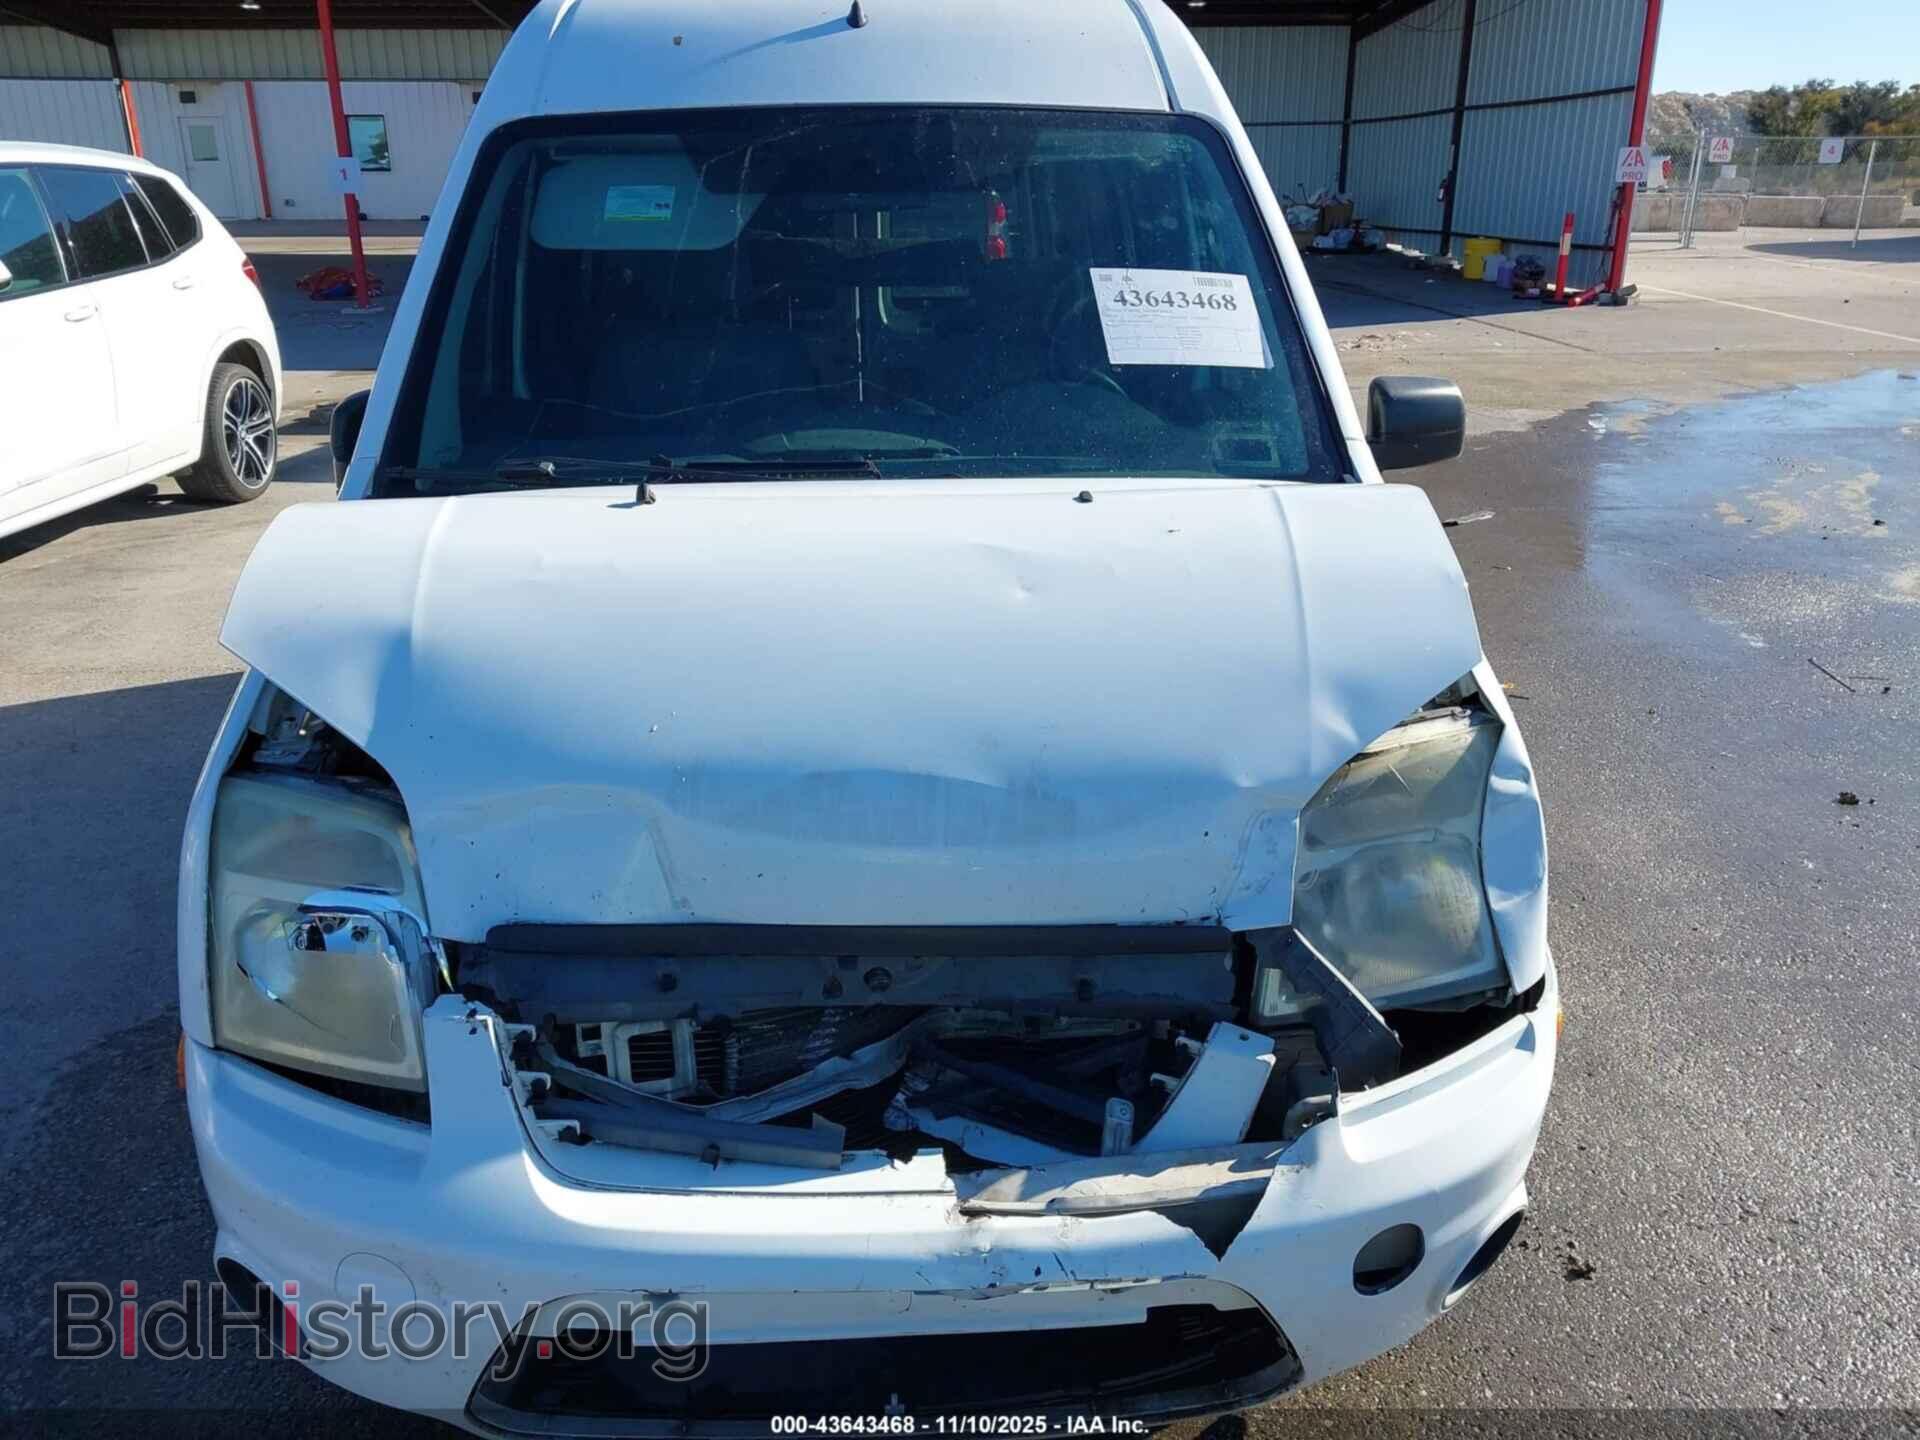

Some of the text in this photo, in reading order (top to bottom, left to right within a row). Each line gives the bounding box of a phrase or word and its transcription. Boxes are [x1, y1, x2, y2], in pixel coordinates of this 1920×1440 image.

[340, 168, 348, 180] 1
[1622, 171, 1643, 180] PRO
[1113, 290, 1237, 311] 43643468
